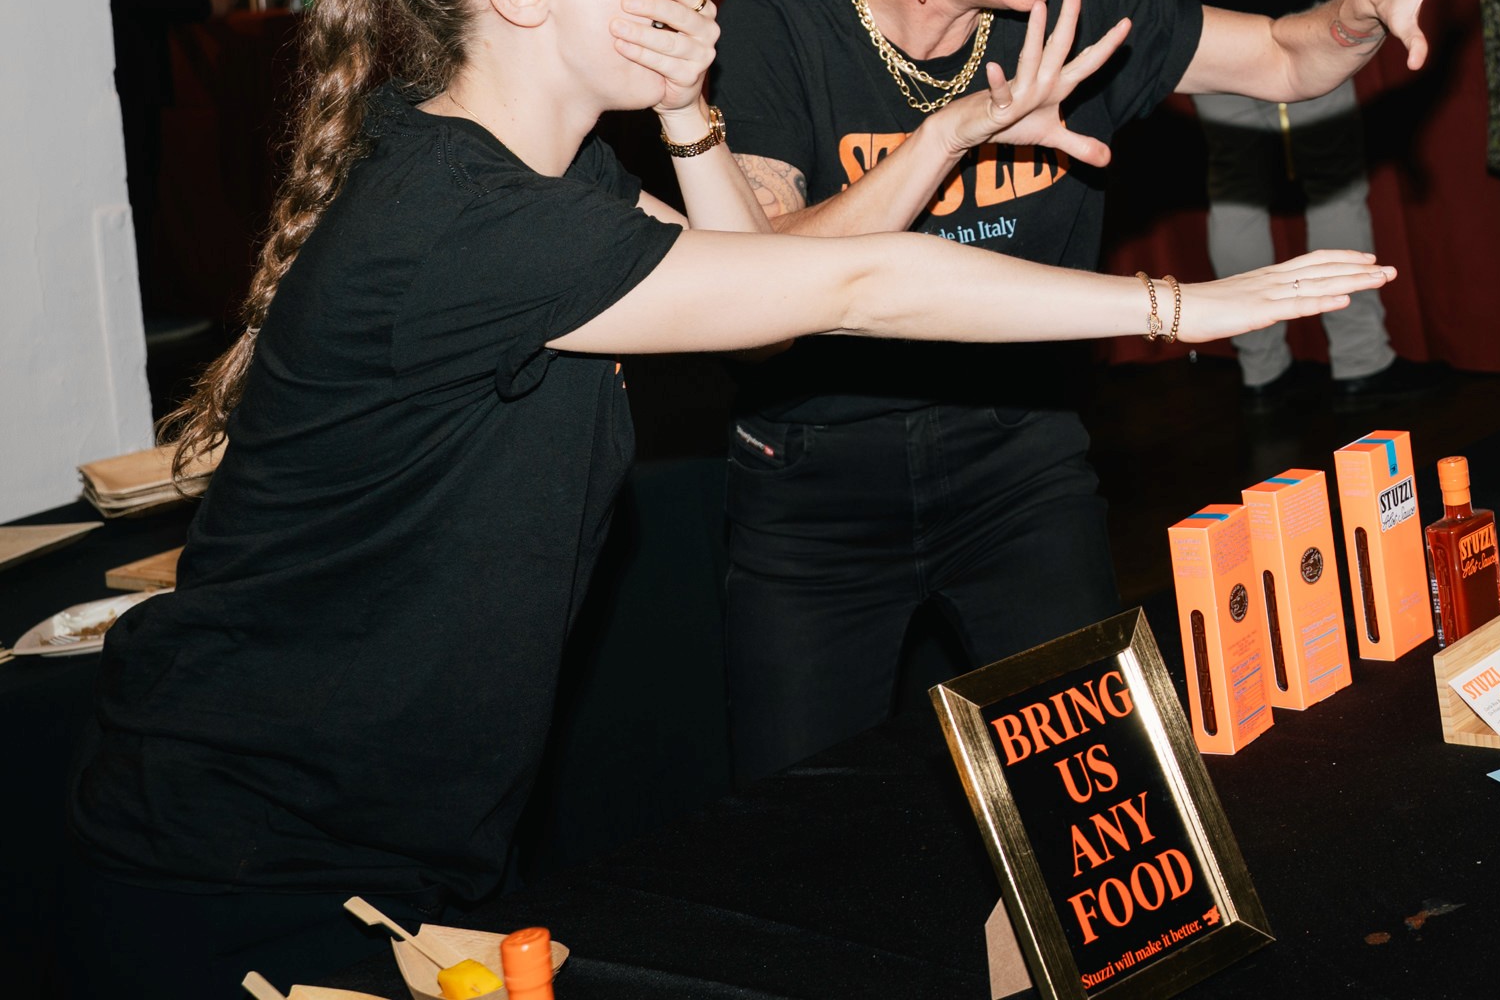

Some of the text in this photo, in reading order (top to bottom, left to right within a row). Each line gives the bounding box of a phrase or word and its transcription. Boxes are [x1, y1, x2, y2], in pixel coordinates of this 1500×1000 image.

[957, 226, 976, 243] in
[978, 217, 1017, 238] Italy
[1380, 480, 1413, 513] STUZZI
[1460, 526, 1496, 561] STUZZI
[1462, 558, 1478, 578] Hot
[991, 671, 1134, 766] BRING
[1054, 744, 1118, 803] US
[1071, 791, 1155, 877] ANY
[1068, 848, 1193, 944] FOOD
[1081, 920, 1202, 989] Stuzzi will make it better.
